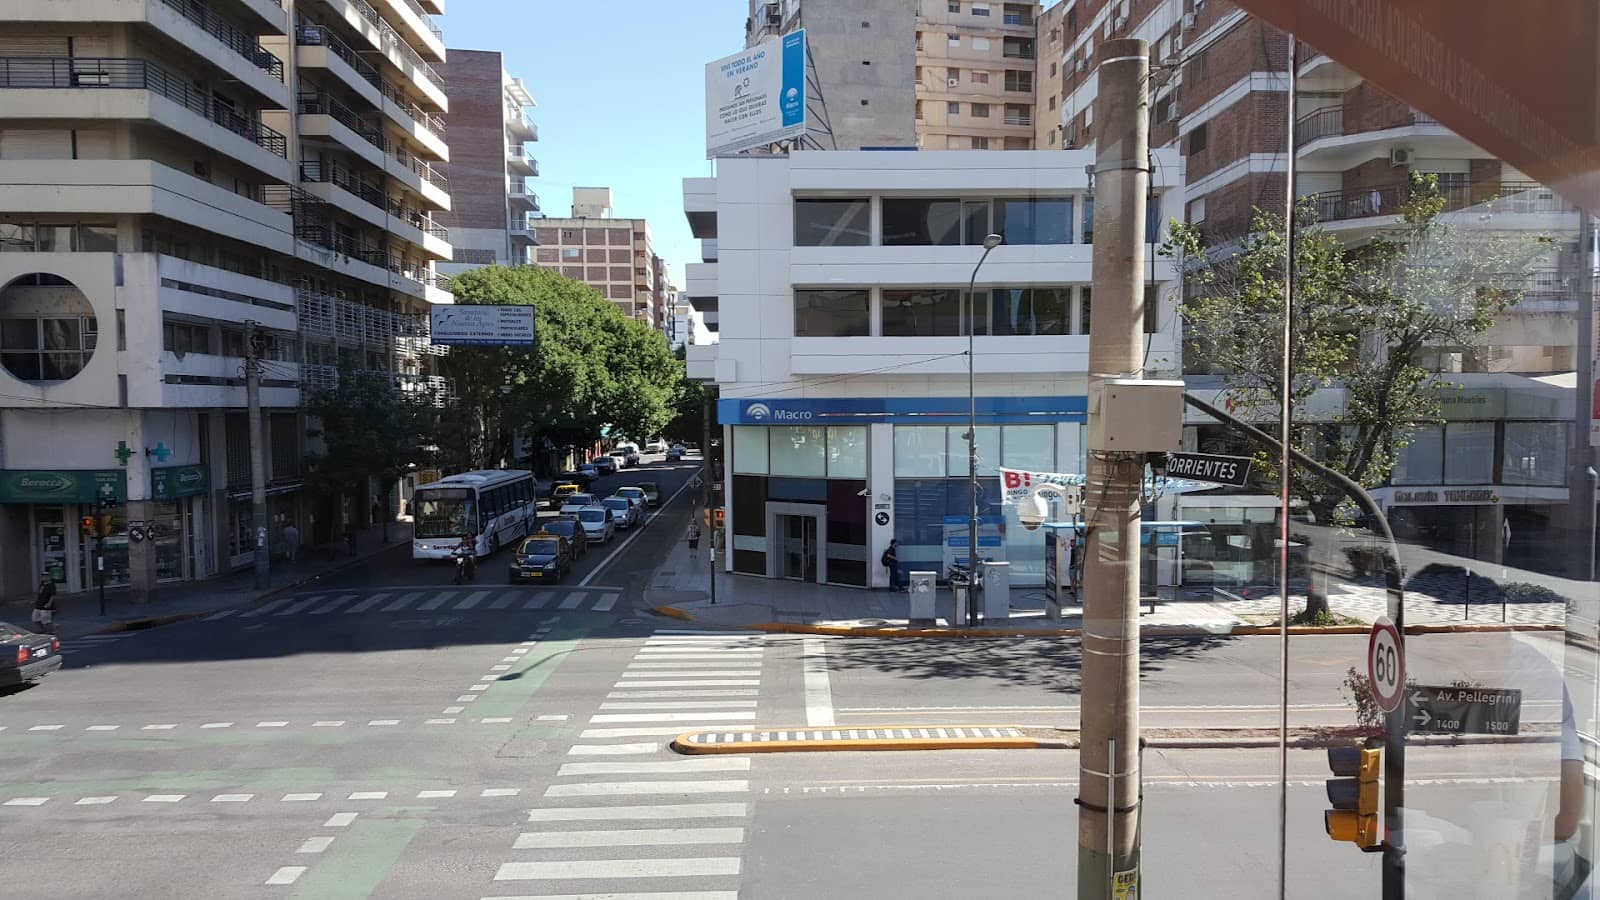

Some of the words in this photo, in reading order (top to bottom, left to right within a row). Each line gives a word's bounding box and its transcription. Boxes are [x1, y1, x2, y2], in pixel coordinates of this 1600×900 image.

[735, 62, 759, 75] VERANO
[774, 409, 812, 420] Macro
[1168, 457, 1238, 480] ORRIENTES
[20, 477, 63, 488] Berocca
[1375, 642, 1396, 687] 60
[1436, 690, 1456, 703] Av.
[1458, 690, 1516, 706] Pellegrini
[1436, 719, 1460, 729] 1400
[1485, 720, 1509, 730] 1500
